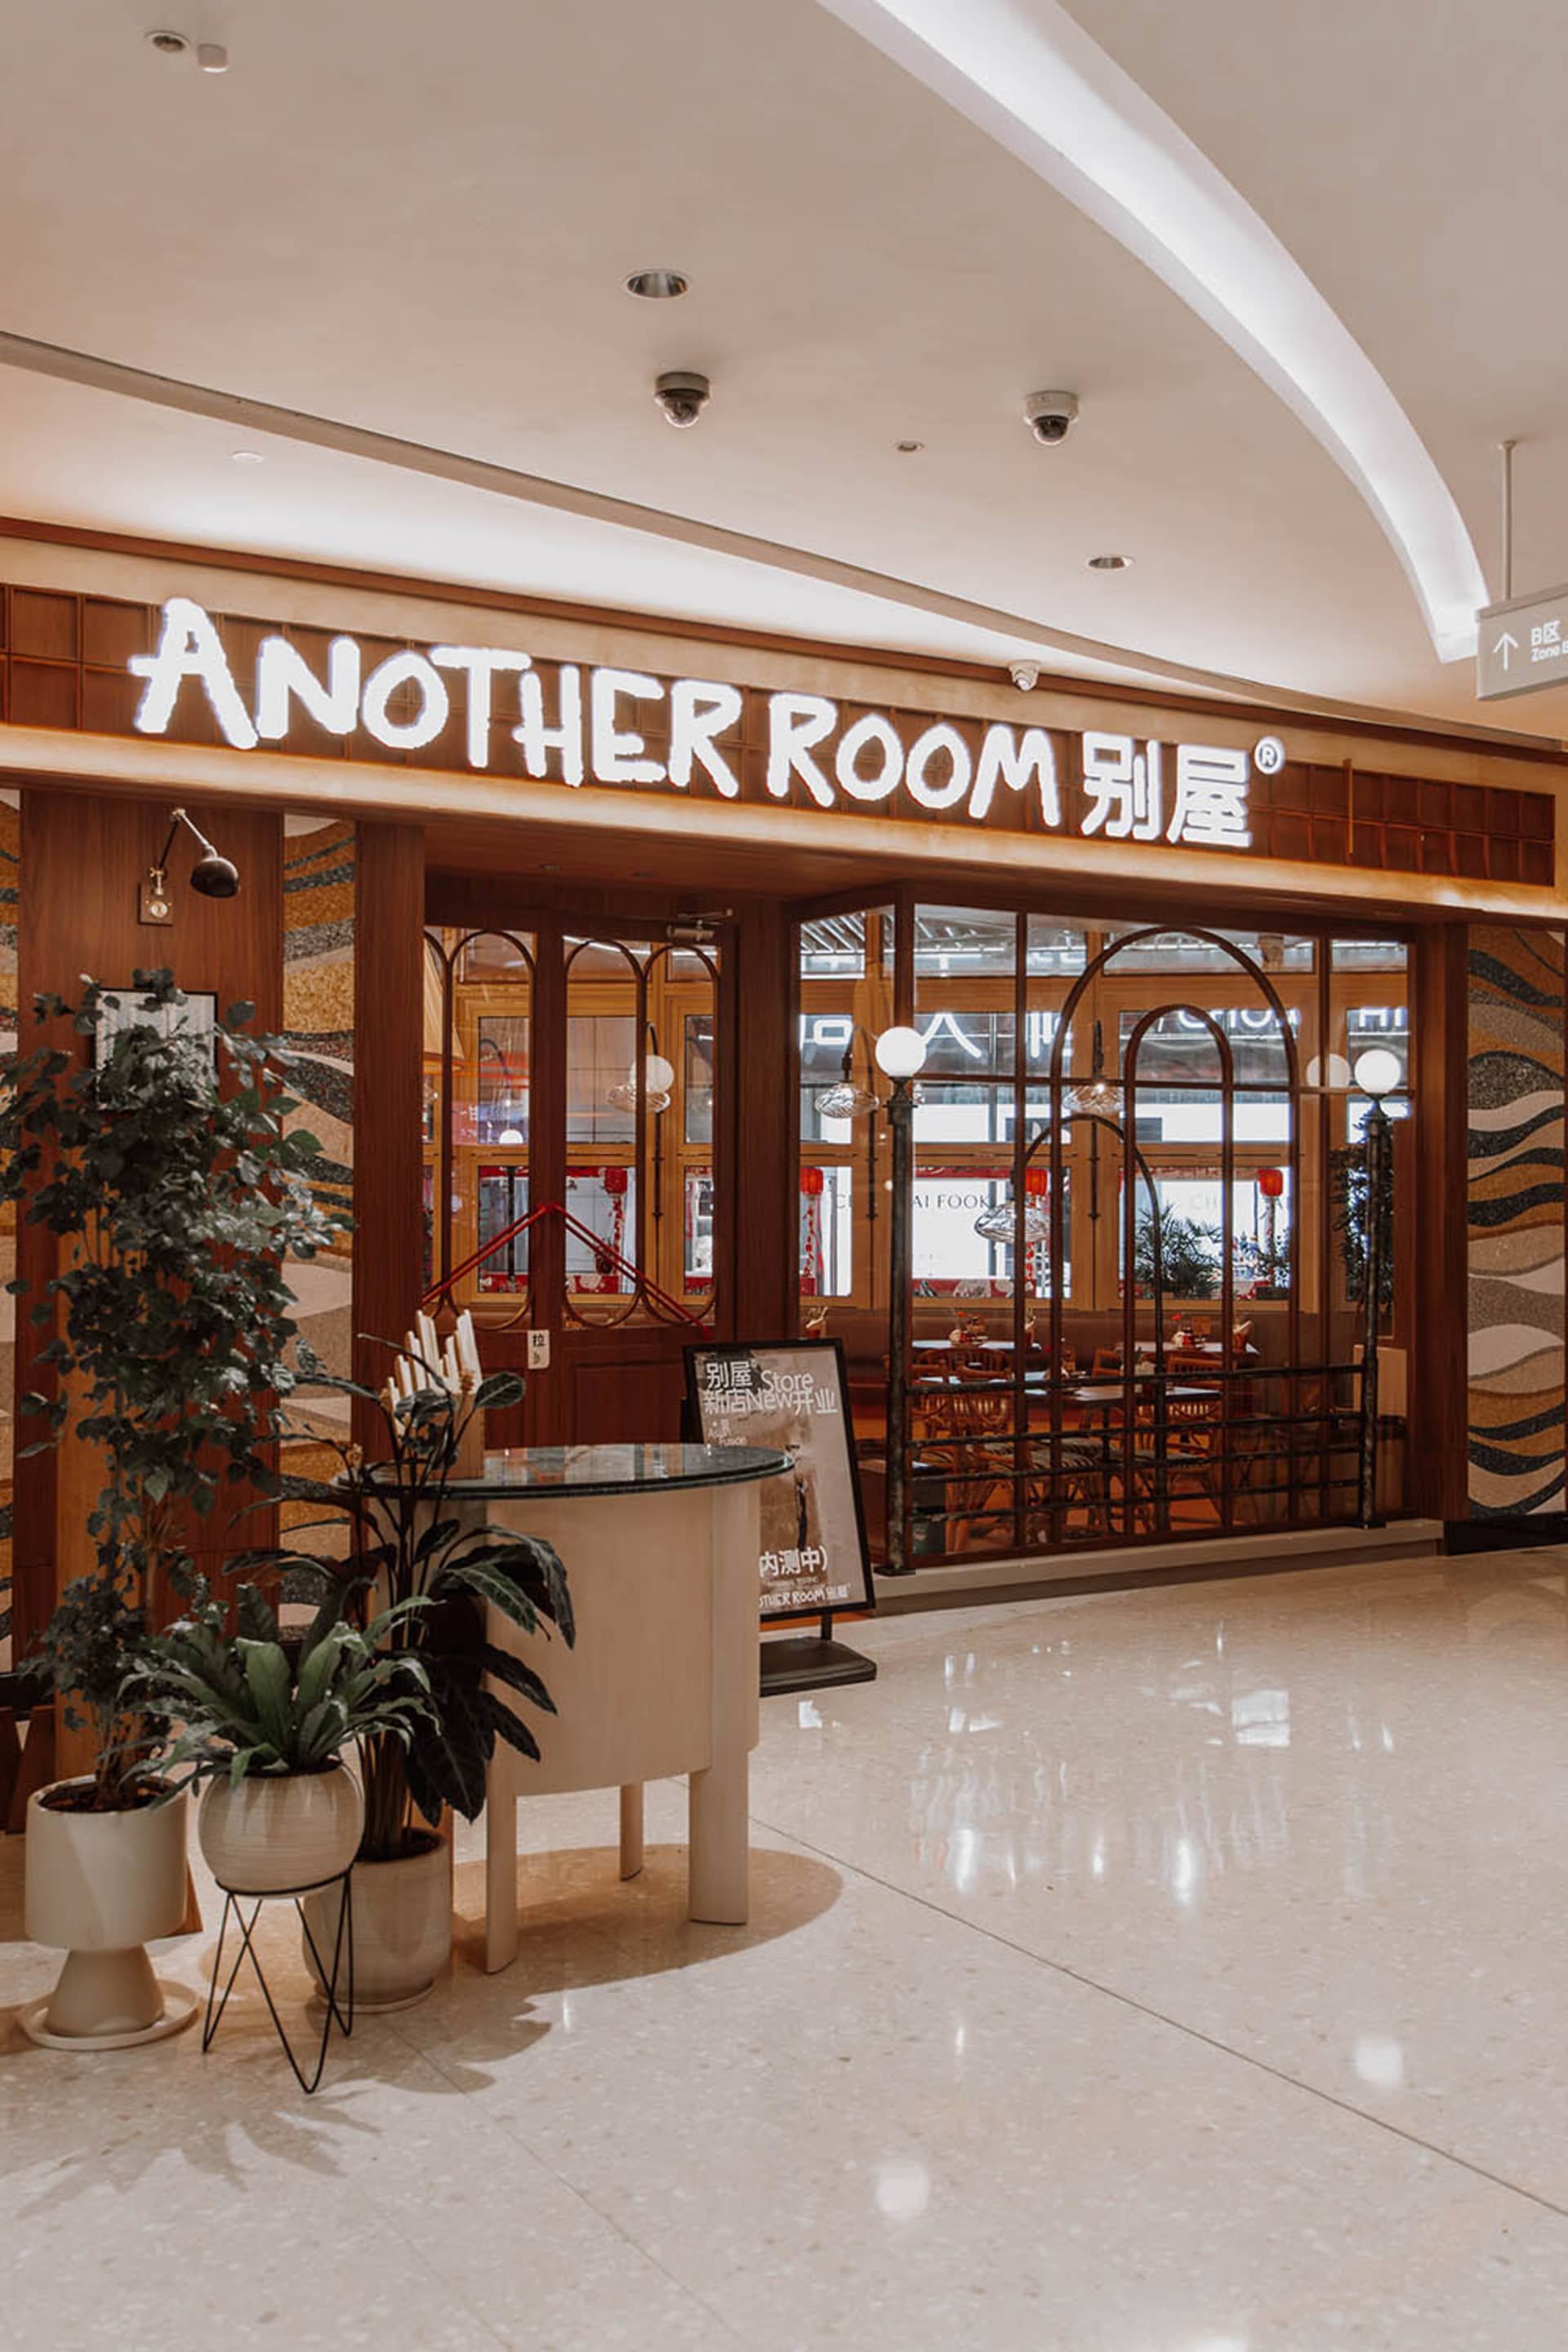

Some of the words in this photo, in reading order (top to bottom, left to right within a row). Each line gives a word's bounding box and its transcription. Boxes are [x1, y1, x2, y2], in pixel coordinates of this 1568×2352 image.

[1530, 620, 1561, 646] B区
[1531, 645, 1561, 662] Zone
[127, 597, 738, 798] ANOTHER
[767, 693, 1060, 826] ROOM
[938, 1194, 991, 1209] FOOK
[760, 1370, 814, 1393] Store
